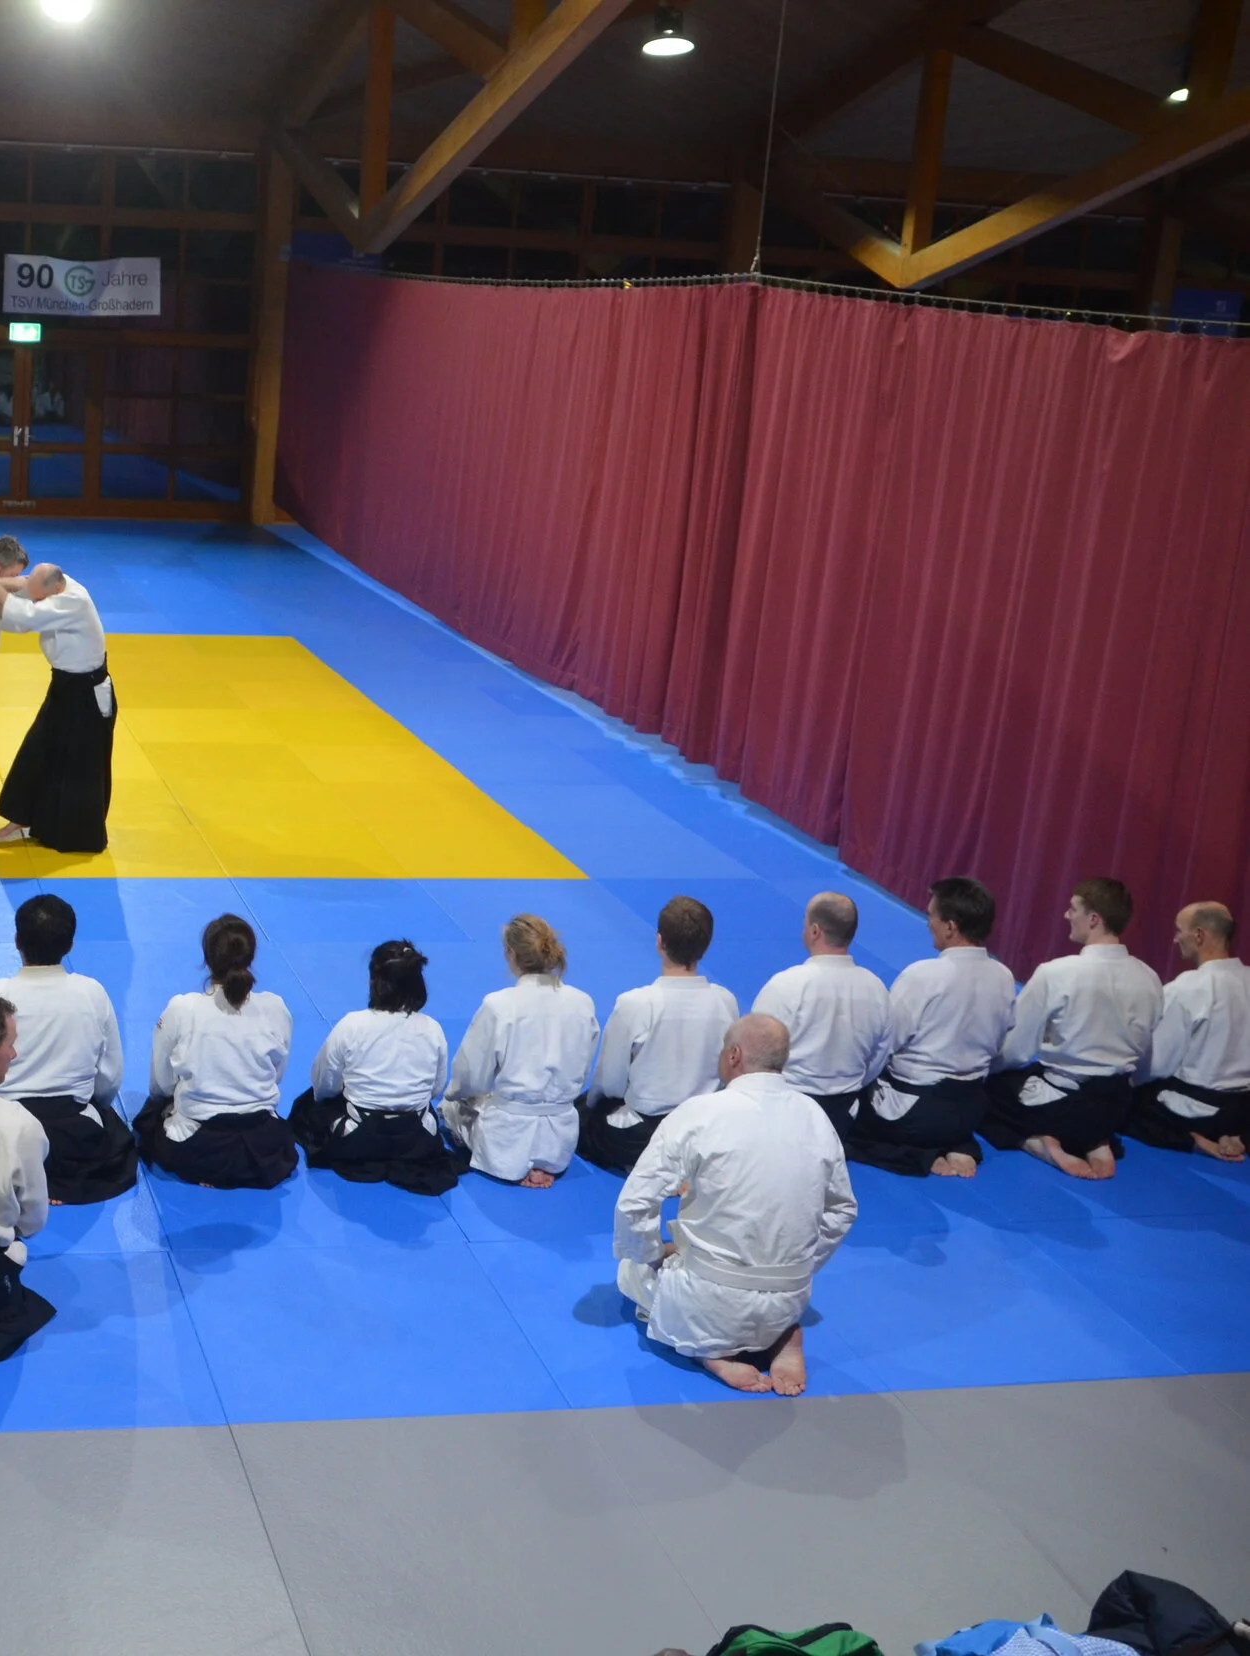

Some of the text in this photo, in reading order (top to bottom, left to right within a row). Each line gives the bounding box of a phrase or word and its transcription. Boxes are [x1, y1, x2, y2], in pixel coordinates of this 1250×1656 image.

[16, 263, 54, 289] 90
[101, 271, 148, 287] Jahre
[10, 295, 33, 309] TSV
